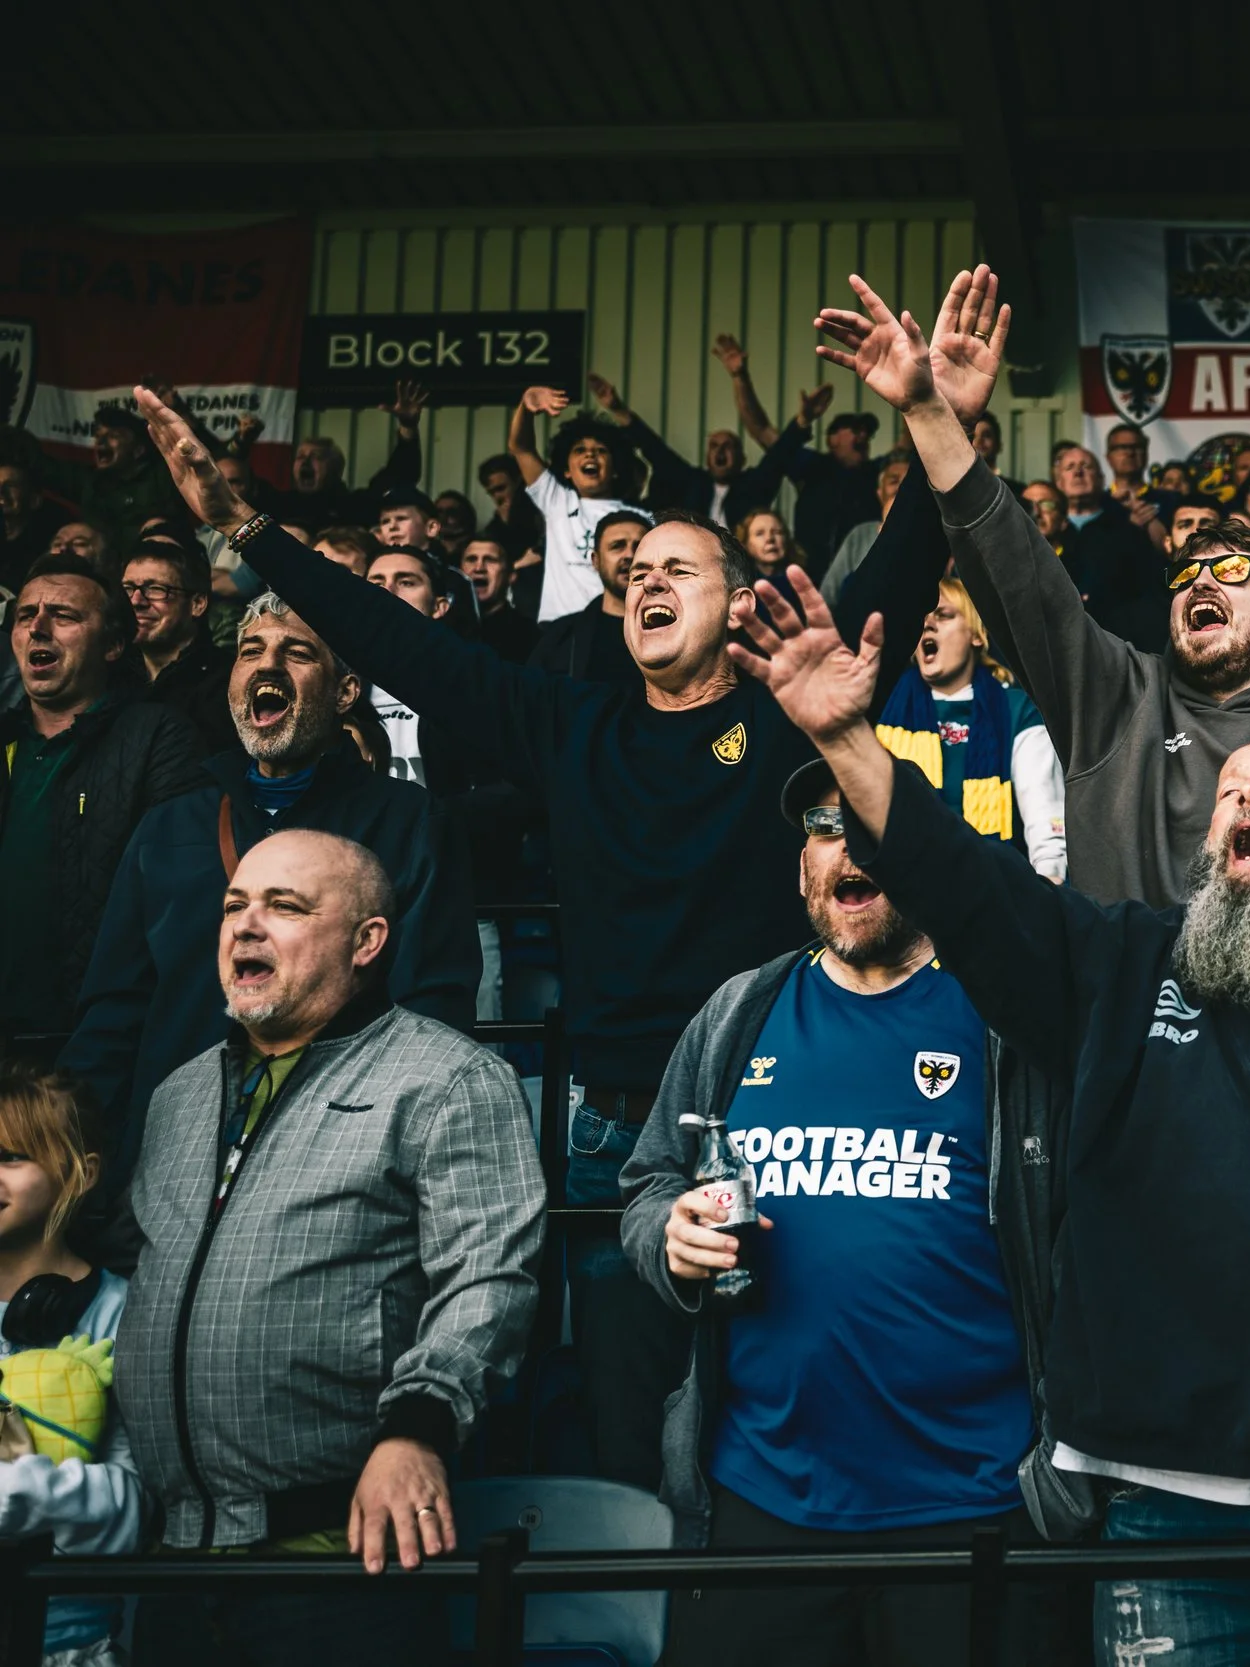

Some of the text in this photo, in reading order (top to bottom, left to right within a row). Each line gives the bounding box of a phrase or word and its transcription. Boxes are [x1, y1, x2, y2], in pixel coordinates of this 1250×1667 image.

[0, 250, 262, 306] EDANES
[328, 330, 550, 368] Block 132
[1149, 1021, 1199, 1044] BRO
